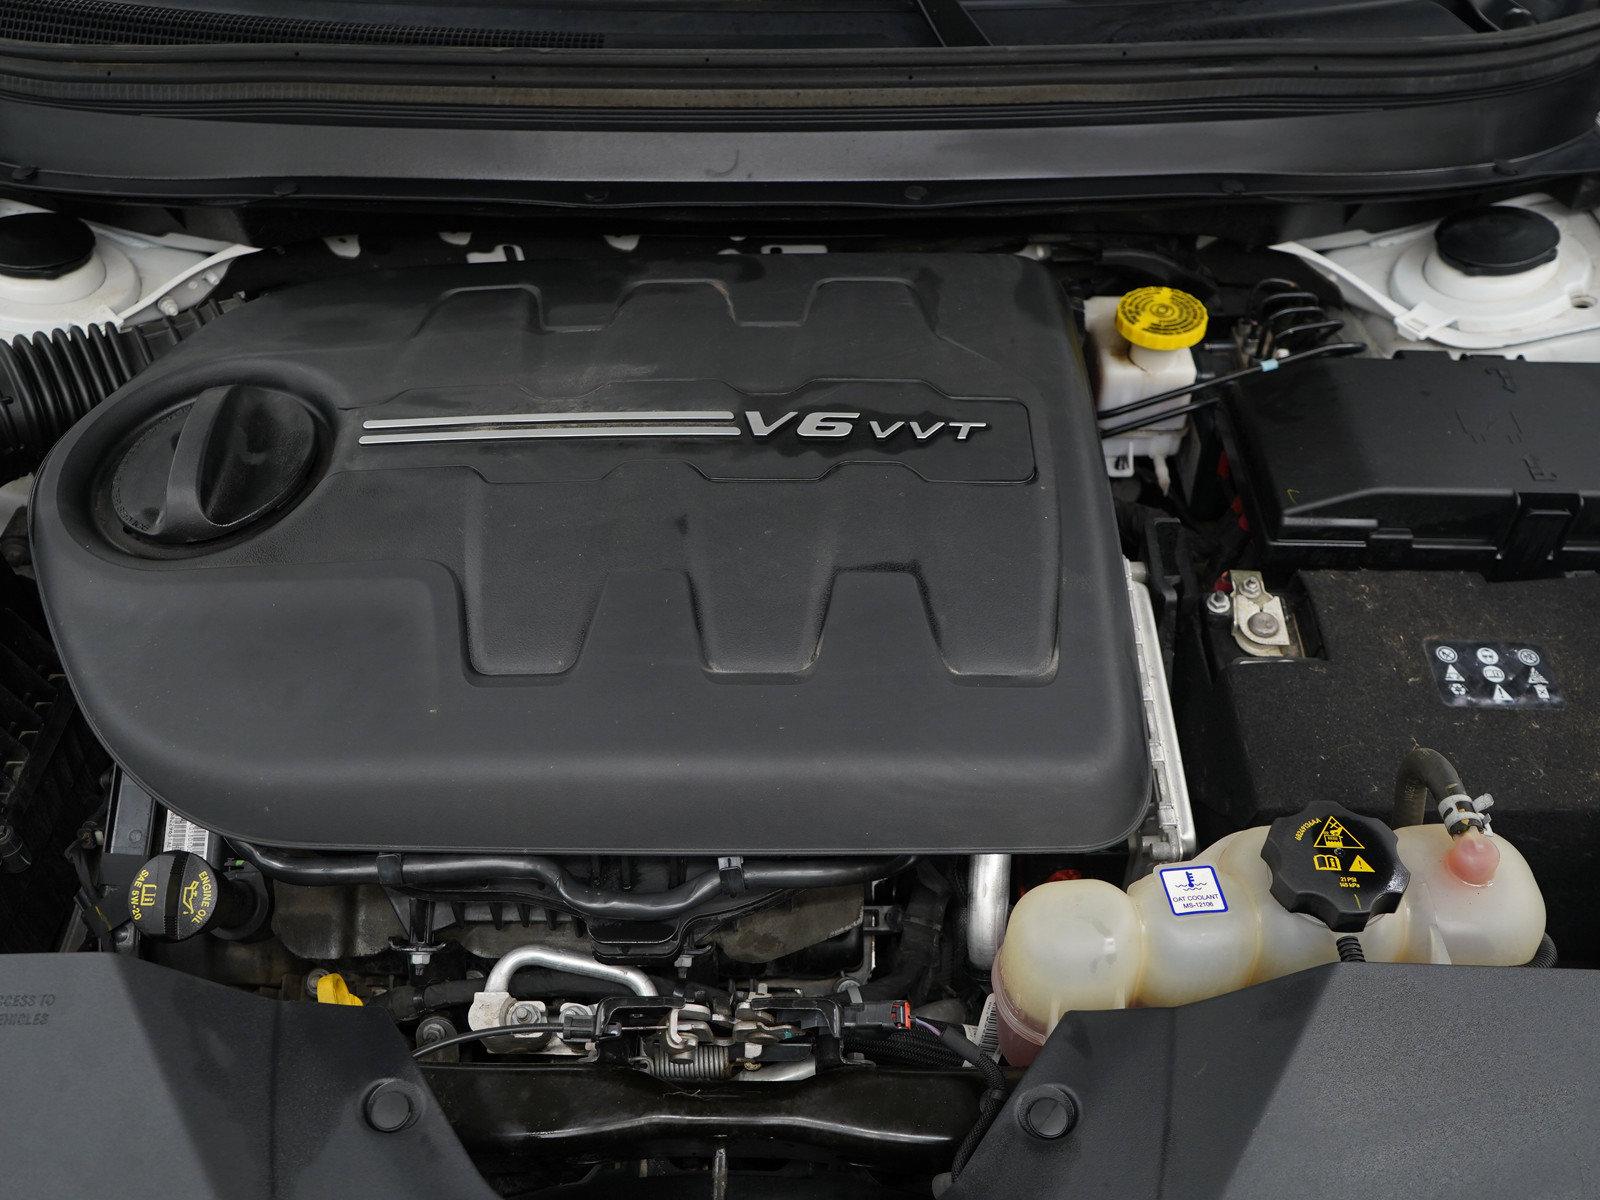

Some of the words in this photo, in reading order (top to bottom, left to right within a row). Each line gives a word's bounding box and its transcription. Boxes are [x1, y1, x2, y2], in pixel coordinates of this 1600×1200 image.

[745, 410, 861, 438] V6
[869, 420, 987, 440] VVT
[133, 869, 150, 889] SAE
[198, 870, 211, 907] ENGINE
[1187, 893, 1219, 901] COOLANT
[130, 889, 142, 921] 5W-20
[1183, 901, 1214, 909] MS-12106
[191, 908, 207, 924] OIL
[39, 993, 56, 1006] TO
